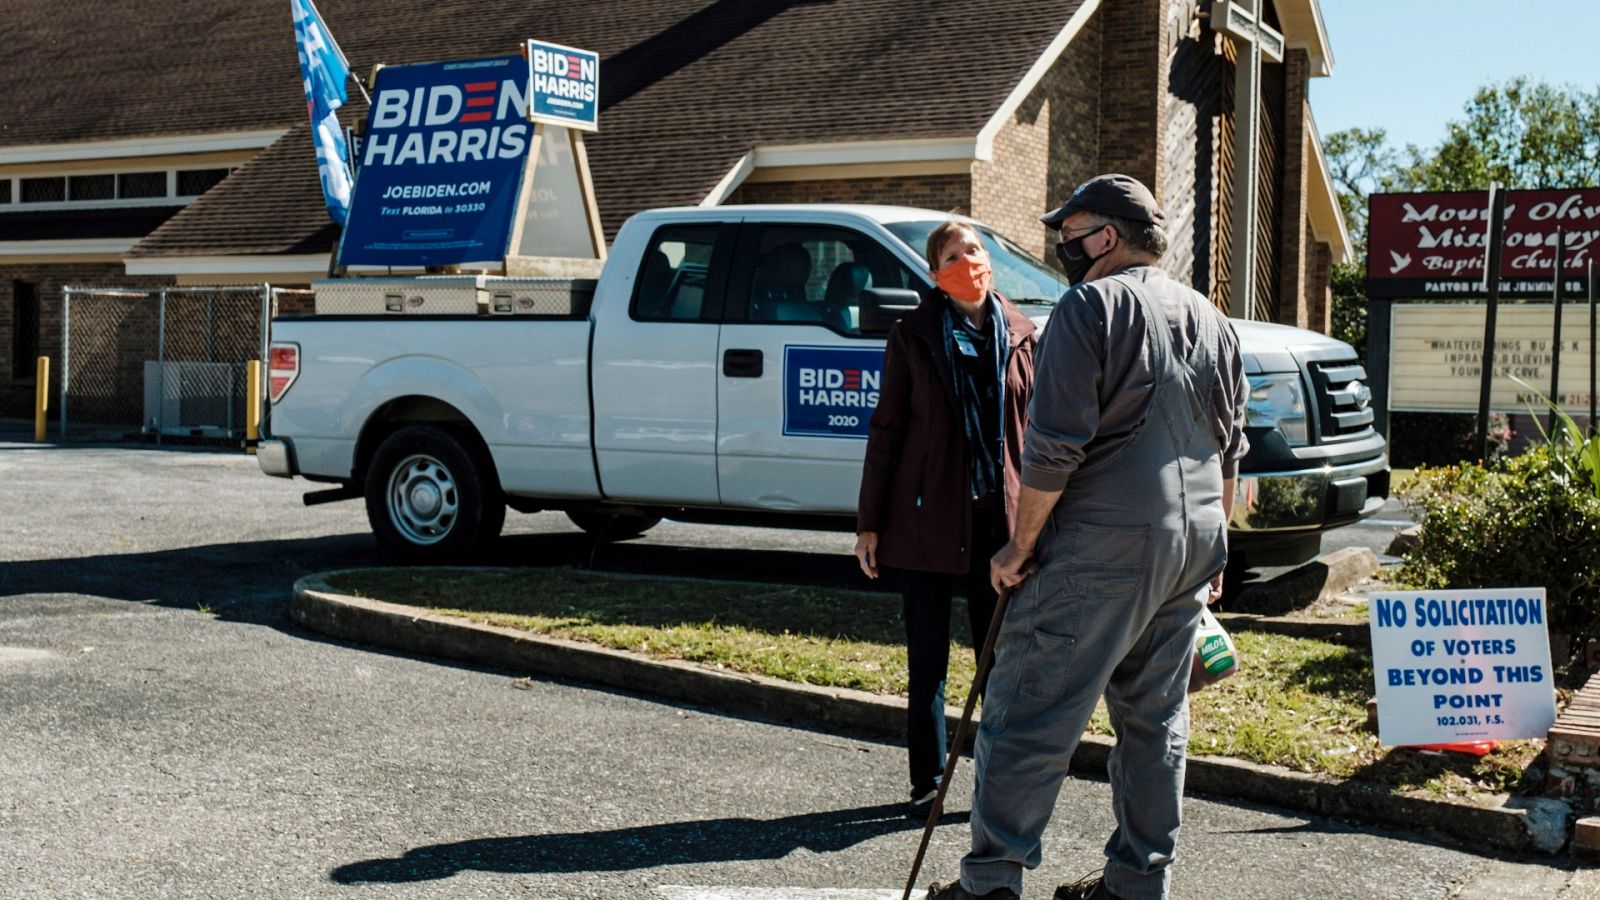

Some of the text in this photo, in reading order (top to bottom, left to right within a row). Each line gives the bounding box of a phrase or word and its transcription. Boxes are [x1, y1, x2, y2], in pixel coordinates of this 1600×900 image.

[533, 49, 594, 82] BIDEN
[534, 73, 595, 103] HARRIS
[372, 78, 530, 128] BIDEN
[364, 125, 528, 166] HARRIS
[382, 181, 491, 199] JOEBIDEN.COM
[381, 207, 401, 216] Text
[402, 205, 443, 216] FLORIDA
[455, 203, 486, 214] 30330
[1418, 225, 1600, 250] Missonary
[1422, 255, 1486, 276] Bapti
[1425, 281, 1469, 292] PASTOR
[799, 368, 880, 390] BIDEN
[799, 389, 880, 408] HARRIS
[828, 415, 859, 427] 2020
[1376, 597, 1542, 627] NO SOLICITATION
[1411, 638, 1516, 656] OF VOTERS
[1387, 665, 1543, 686] BEYOND THIS
[1433, 694, 1503, 709] POINT
[1437, 715, 1505, 727] 102.031, F.S.
